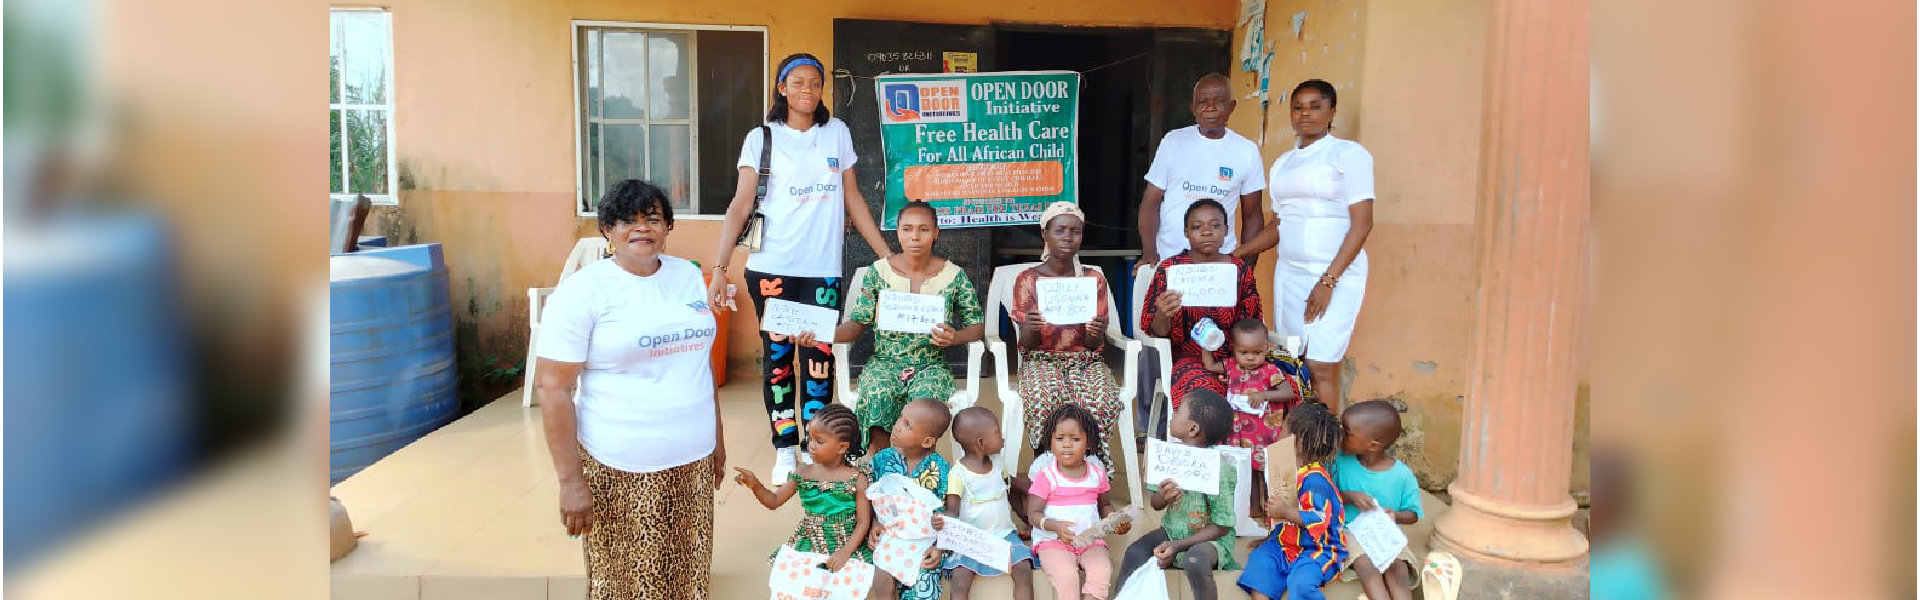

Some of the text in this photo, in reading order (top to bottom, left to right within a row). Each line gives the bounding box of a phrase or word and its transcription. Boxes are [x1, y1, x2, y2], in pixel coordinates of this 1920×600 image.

[920, 87, 959, 98] OPEN
[971, 80, 1068, 100] OPEN DOOR
[920, 98, 960, 110] DOOR
[986, 100, 1059, 116] Initiative
[915, 120, 1069, 144] Free Health Care
[918, 142, 1065, 162] For All African Child
[789, 183, 838, 196] Open Door
[1183, 181, 1207, 192] Open
[639, 328, 714, 348] Open Door
